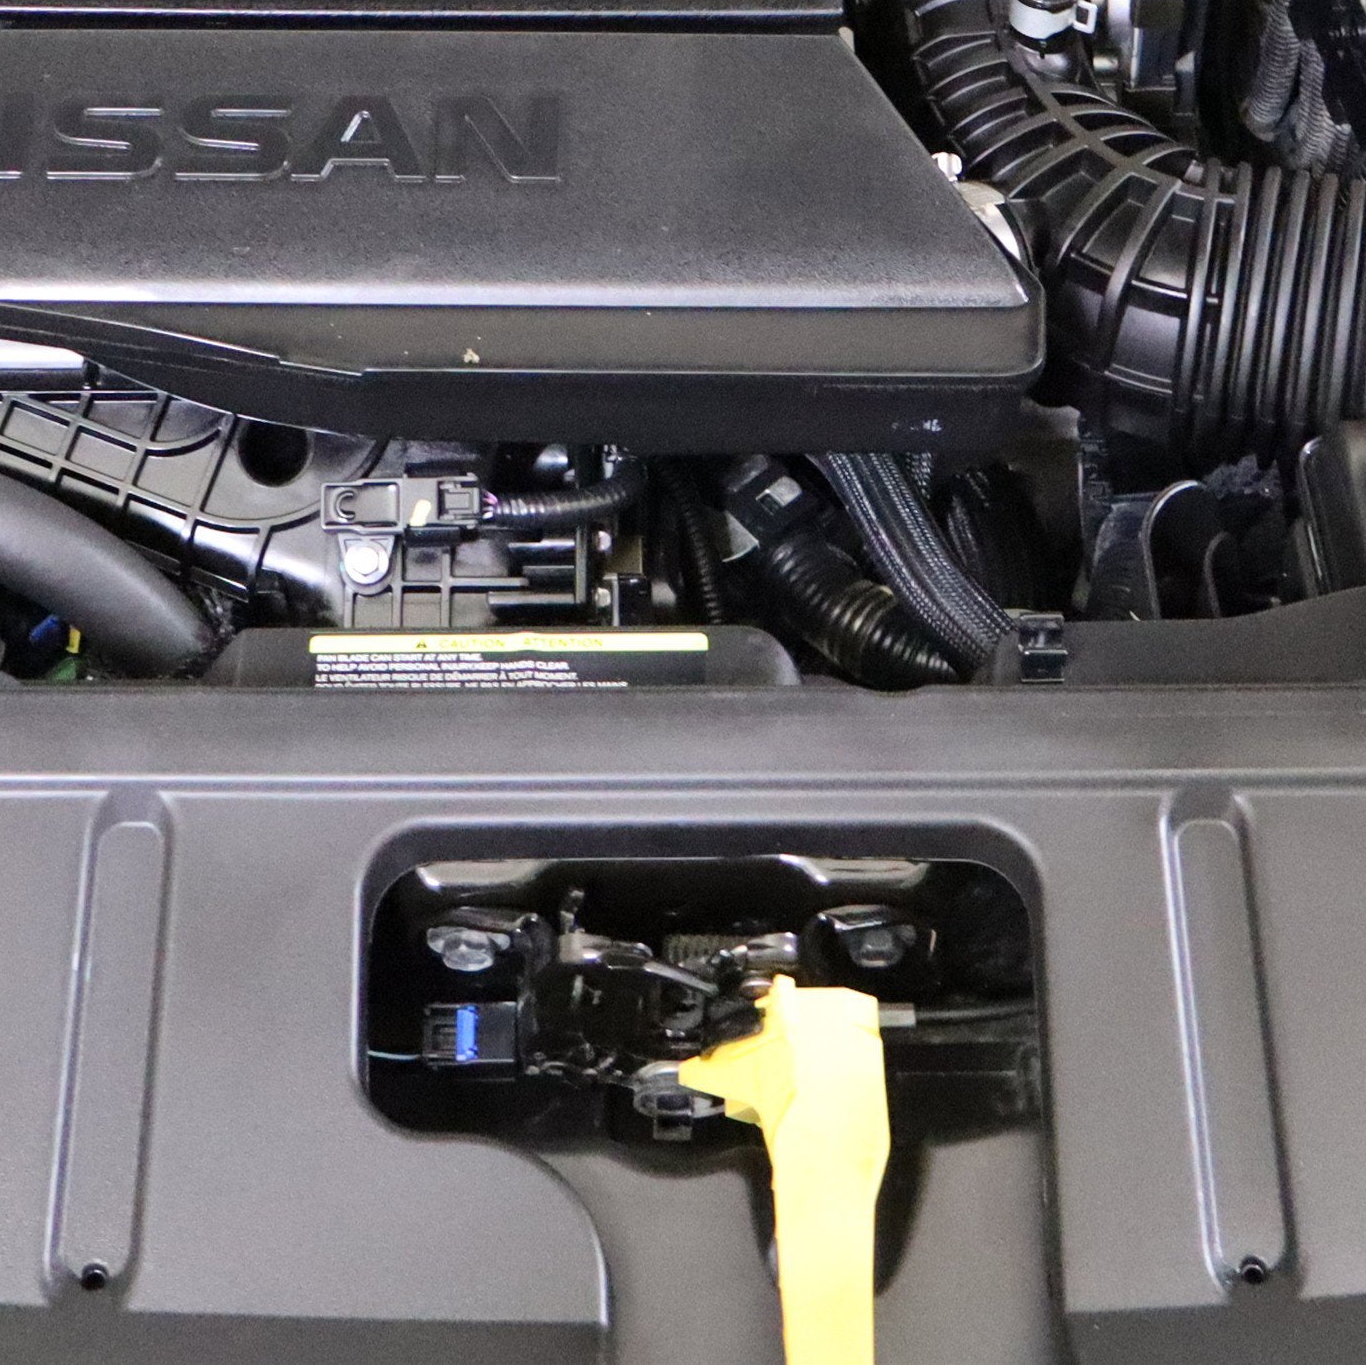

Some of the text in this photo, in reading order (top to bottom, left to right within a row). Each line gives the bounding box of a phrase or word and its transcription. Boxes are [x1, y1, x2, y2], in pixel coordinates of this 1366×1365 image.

[438, 636, 604, 649] CAUTION ATTENTION
[316, 653, 336, 662] FAN
[337, 653, 369, 662] BLADE
[370, 653, 392, 662] CAN
[393, 653, 423, 662] START
[423, 653, 436, 661] AT
[437, 653, 458, 661] ANY
[316, 663, 331, 671] TO
[331, 663, 358, 671] HELP
[358, 663, 389, 671] AVOID
[389, 662, 441, 671] PERSONAL
[500, 660, 535, 671] HANDS
